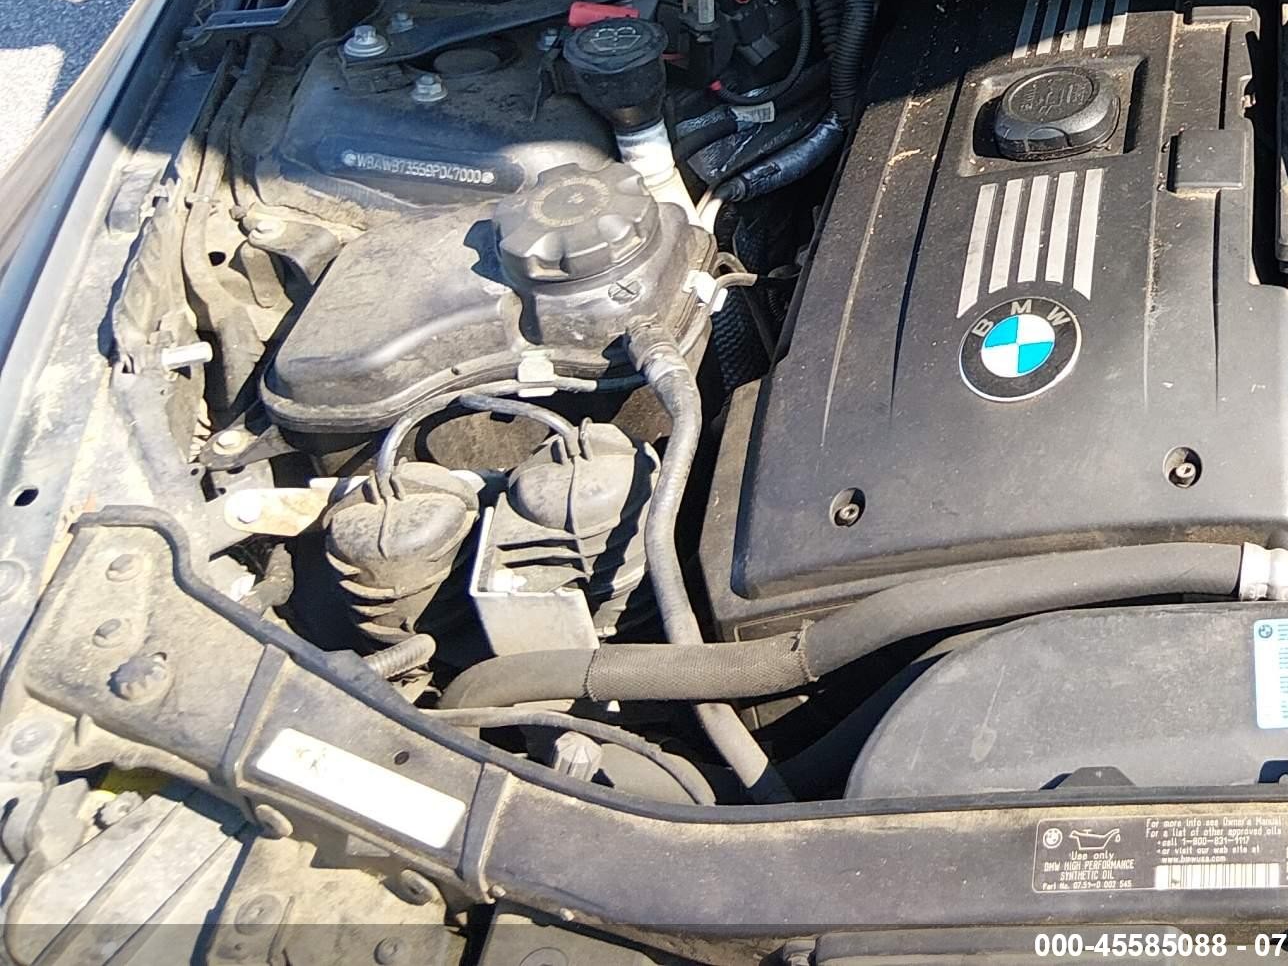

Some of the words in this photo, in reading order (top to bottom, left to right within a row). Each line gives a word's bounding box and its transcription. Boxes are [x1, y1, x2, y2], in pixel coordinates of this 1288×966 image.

[972, 299, 1071, 337] BMW
[1146, 818, 1159, 828] For
[1165, 820, 1181, 828] more
[1205, 819, 1218, 827] see
[1223, 817, 1251, 826] Owner's
[1255, 816, 1281, 825] Manual
[1146, 828, 1159, 837] For
[1172, 828, 1186, 837] list
[1190, 828, 1199, 836] of
[1204, 827, 1224, 836] other
[1228, 826, 1262, 838] approved
[1266, 826, 1281, 835] oils
[1182, 836, 1250, 845] 1-800-831-1117
[1175, 846, 1192, 854] visit
[1214, 845, 1228, 854] web
[1232, 845, 1247, 853] site
[1071, 851, 1087, 860] Use
[1093, 850, 1114, 861] only
[1161, 855, 1226, 863] www.bmwusa.com
[1044, 862, 1060, 871] BMW
[1064, 861, 1081, 871] HIGH
[1084, 859, 1135, 869] PERFORMANCE
[1060, 870, 1098, 881] SYNTHETIC
[1102, 870, 1114, 880] OIL
[1043, 882, 1056, 890] Part
